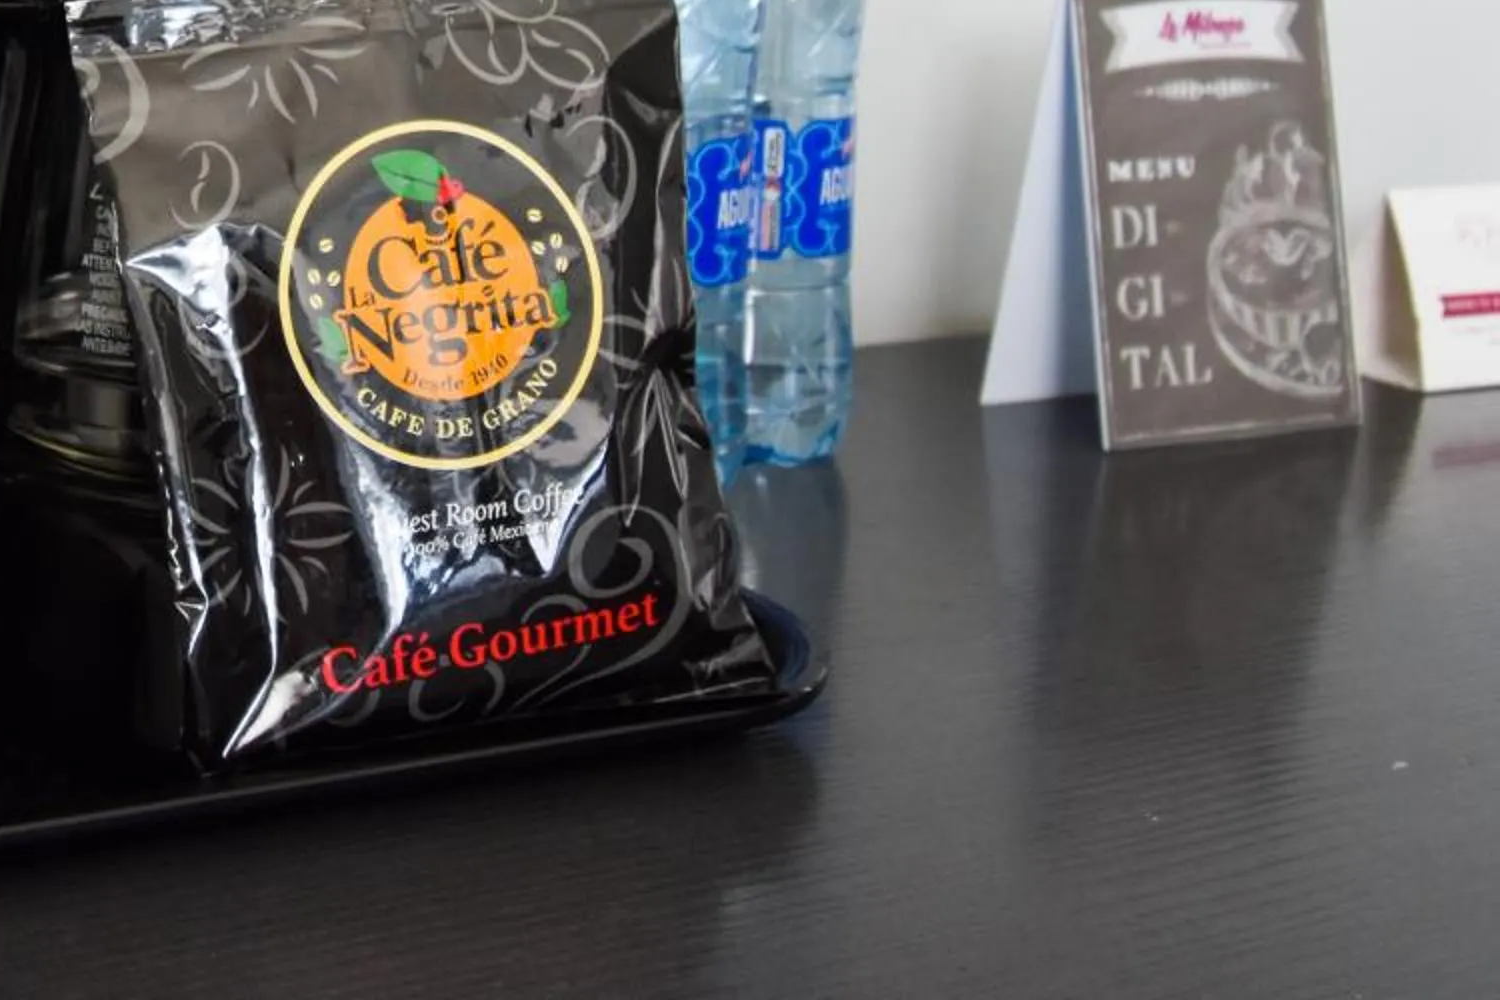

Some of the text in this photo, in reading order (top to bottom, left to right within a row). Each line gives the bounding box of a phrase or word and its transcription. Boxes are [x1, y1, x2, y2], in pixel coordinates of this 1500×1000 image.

[1107, 154, 1196, 183] MENU
[366, 218, 510, 301] Café
[339, 285, 552, 371] La Negrita
[356, 358, 559, 439] CAFE DE GRANO
[402, 366, 466, 393] Desde
[1118, 340, 1214, 392] TAL
[446, 499, 508, 528] Room
[319, 594, 659, 696] Café Gourmet
